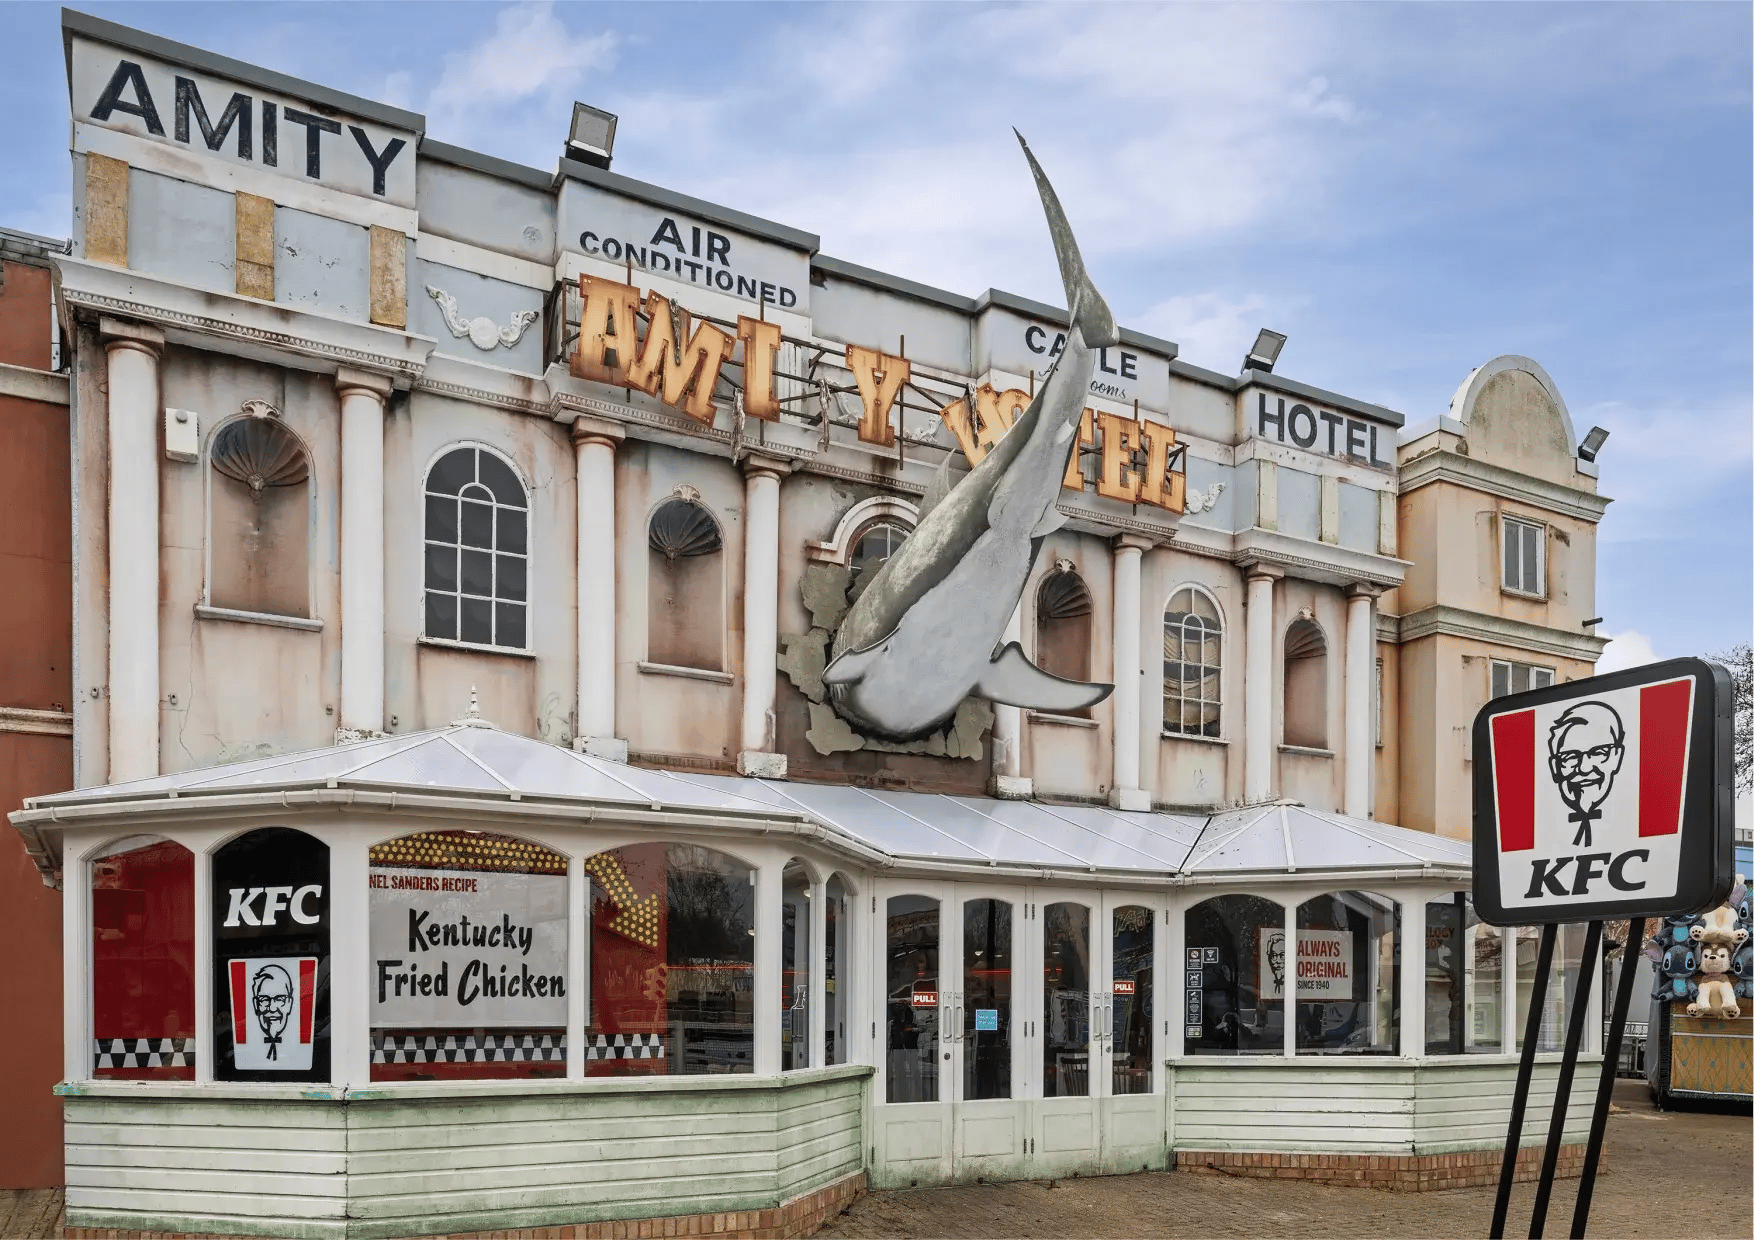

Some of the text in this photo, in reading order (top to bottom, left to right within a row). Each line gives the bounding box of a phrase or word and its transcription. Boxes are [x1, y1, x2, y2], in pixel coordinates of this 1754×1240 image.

[89, 59, 407, 197] AMITY
[650, 217, 731, 267] AIR
[579, 230, 797, 308] CONDITIONED
[1025, 325, 1138, 381] CALE
[1090, 380, 1126, 400] ooms
[1258, 392, 1393, 472] HOTEL
[369, 873, 478, 893] NEL SANDERS RECIPE
[1524, 848, 1650, 899] KFC
[223, 884, 322, 927] KFC
[408, 908, 532, 956] Kentucky
[1297, 940, 1340, 957] ALWAYS
[376, 959, 566, 1006] Fried Chicken
[1114, 983, 1133, 991] PULL
[1297, 961, 1348, 978] ORIGINAL
[1297, 980, 1330, 990] SINCE 1940
[913, 994, 936, 1003] PULL
